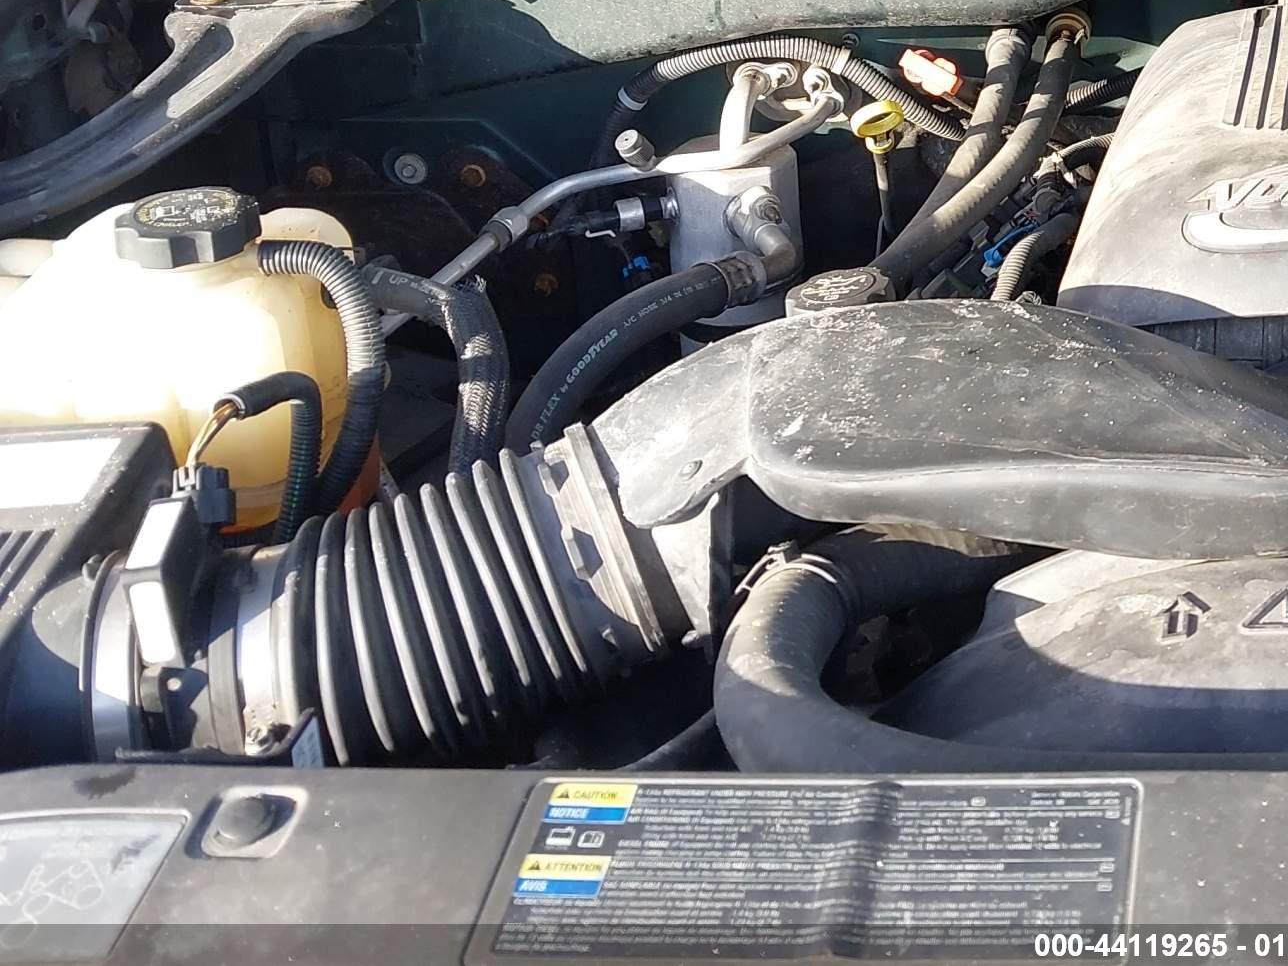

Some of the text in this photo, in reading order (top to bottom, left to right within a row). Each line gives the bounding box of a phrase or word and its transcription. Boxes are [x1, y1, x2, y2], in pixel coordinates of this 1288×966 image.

[388, 274, 409, 286] UP
[565, 328, 619, 384] GOODYEAR
[638, 302, 659, 318] HOSE
[572, 791, 618, 800] CAUTION
[549, 808, 589, 819] NOTICE
[545, 862, 603, 872] ATTENTION
[519, 881, 548, 892] AVIS
